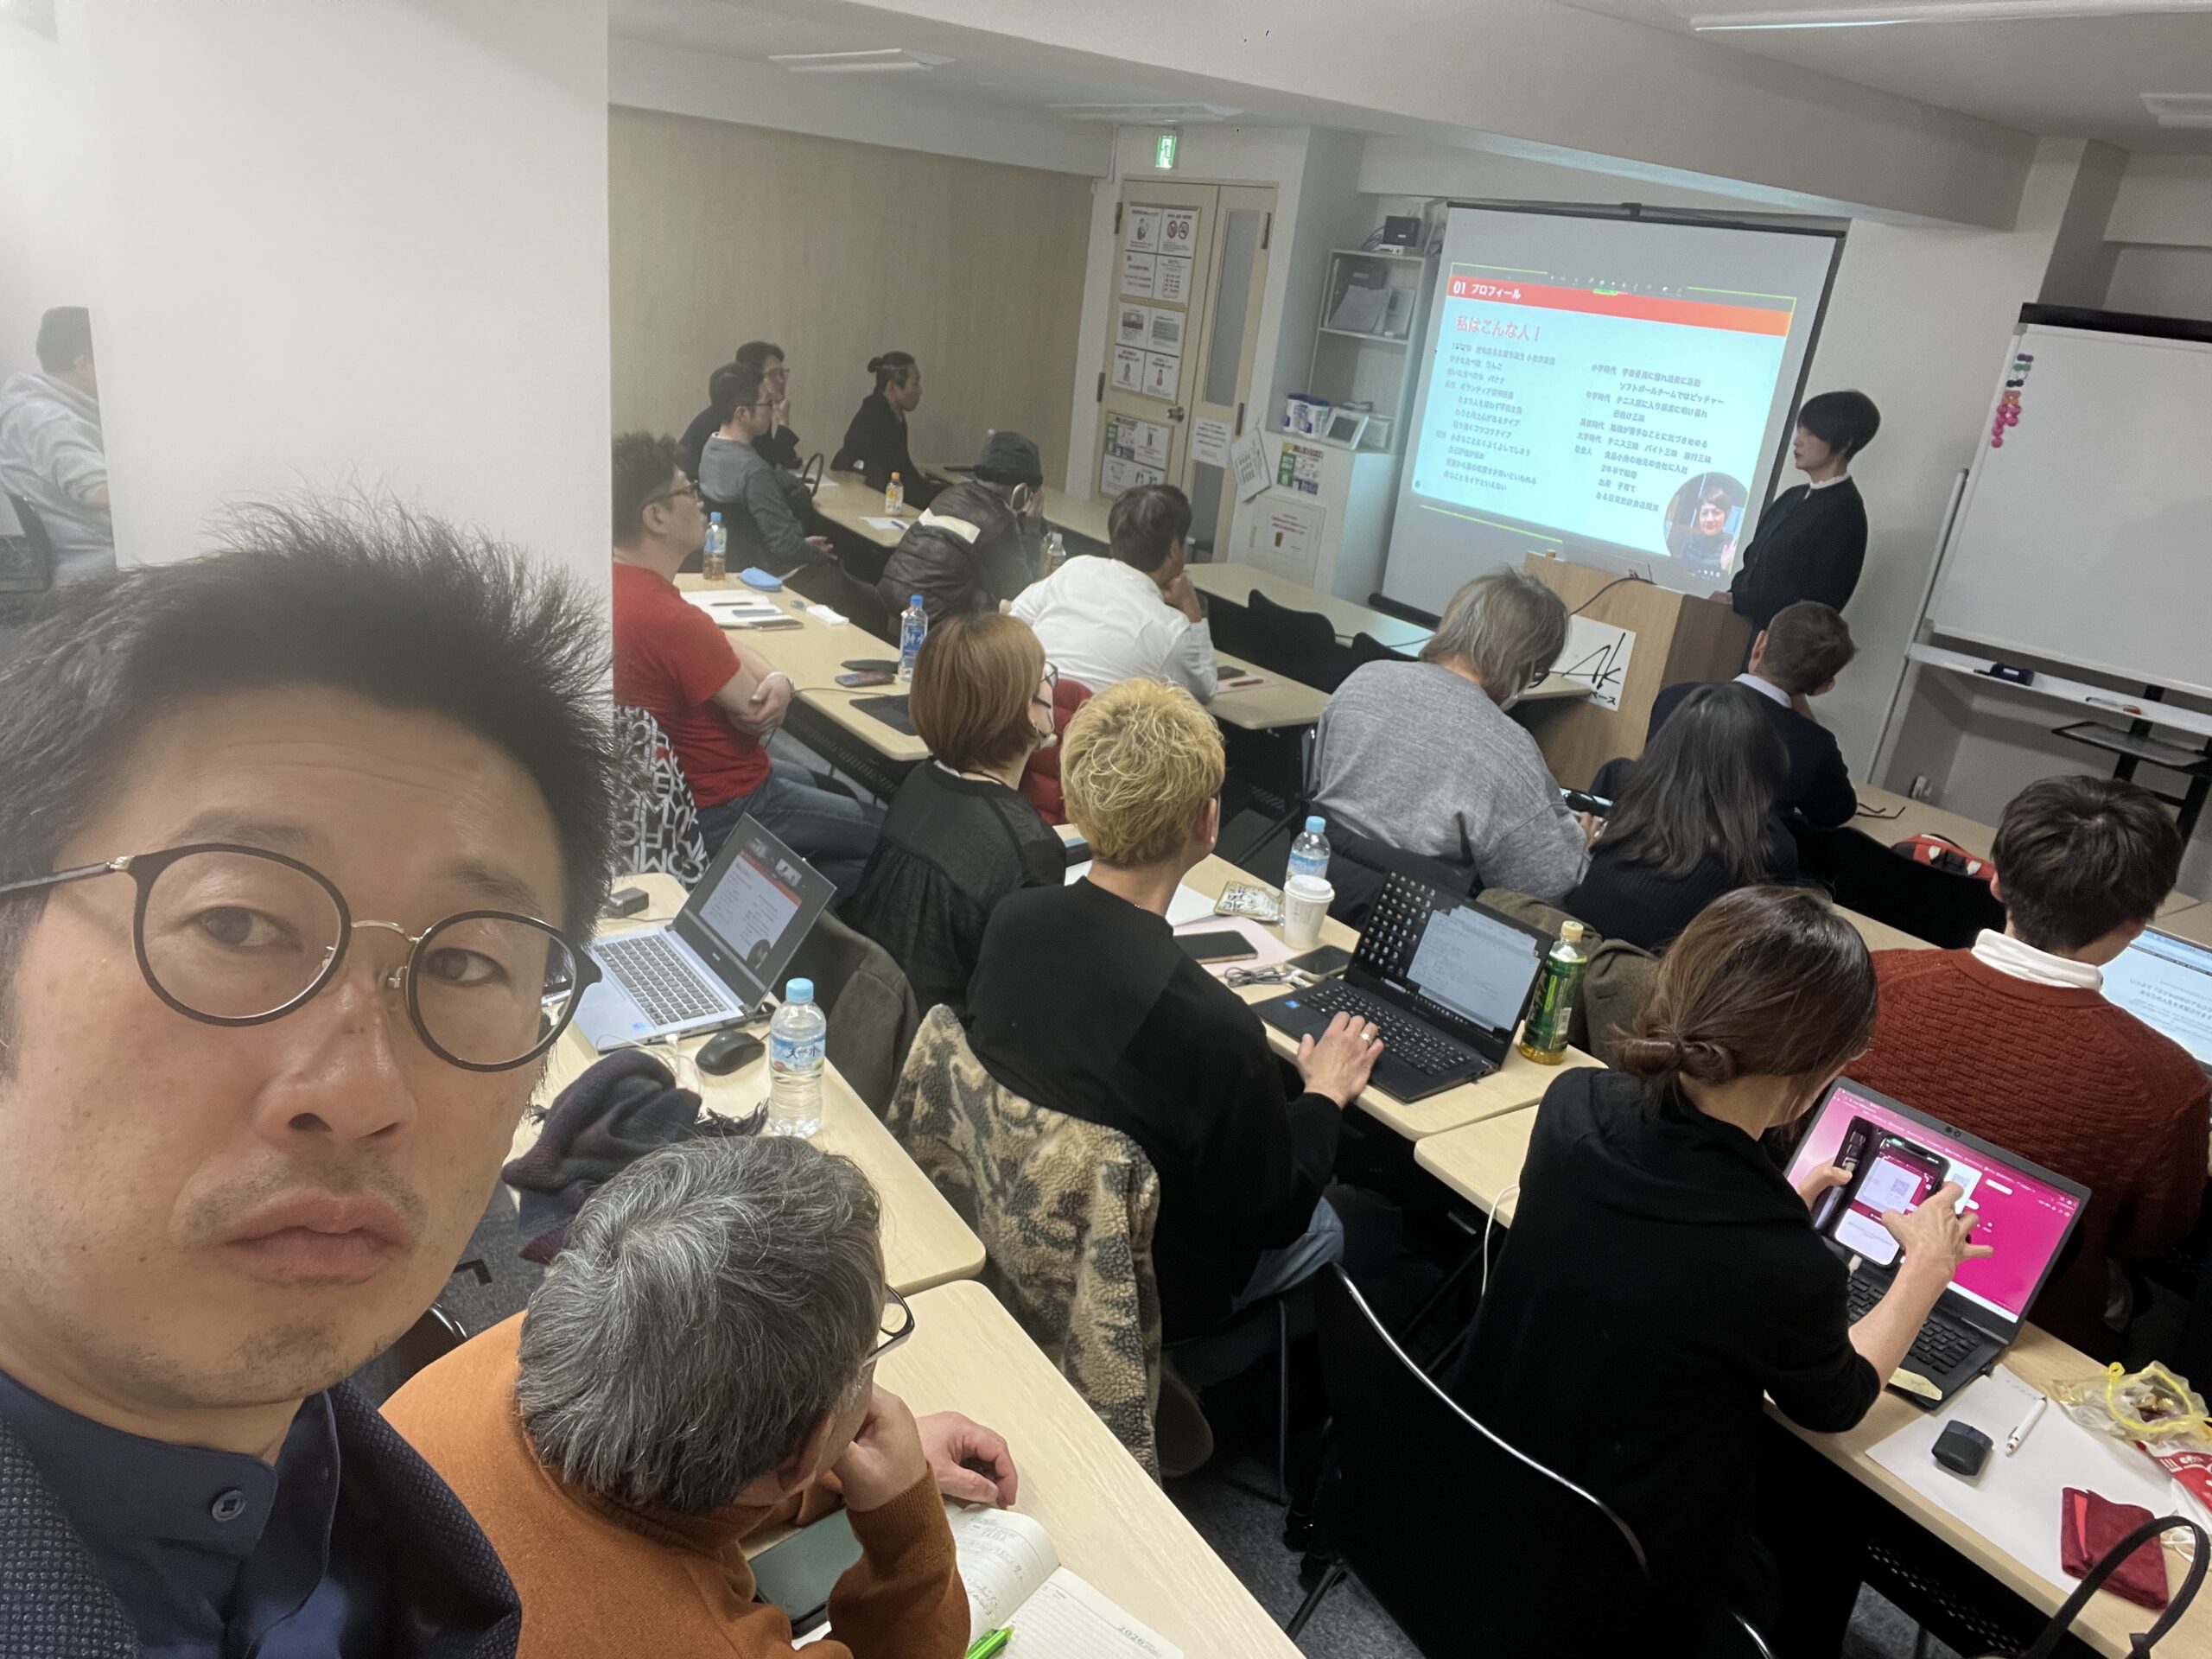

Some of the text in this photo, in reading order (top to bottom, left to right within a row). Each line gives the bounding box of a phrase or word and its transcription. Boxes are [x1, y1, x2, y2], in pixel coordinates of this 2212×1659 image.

[1453, 282, 1521, 299] 01 プロフィール
[1456, 316, 1540, 343] 私はこんな人！
[1586, 392, 1610, 403] 中学時代
[1620, 383, 1724, 406] ソフトボールチームではピッチャー
[1578, 433, 1601, 443] 大学時代
[1575, 446, 1592, 455] 社会人
[1618, 483, 1636, 493] 子育て
